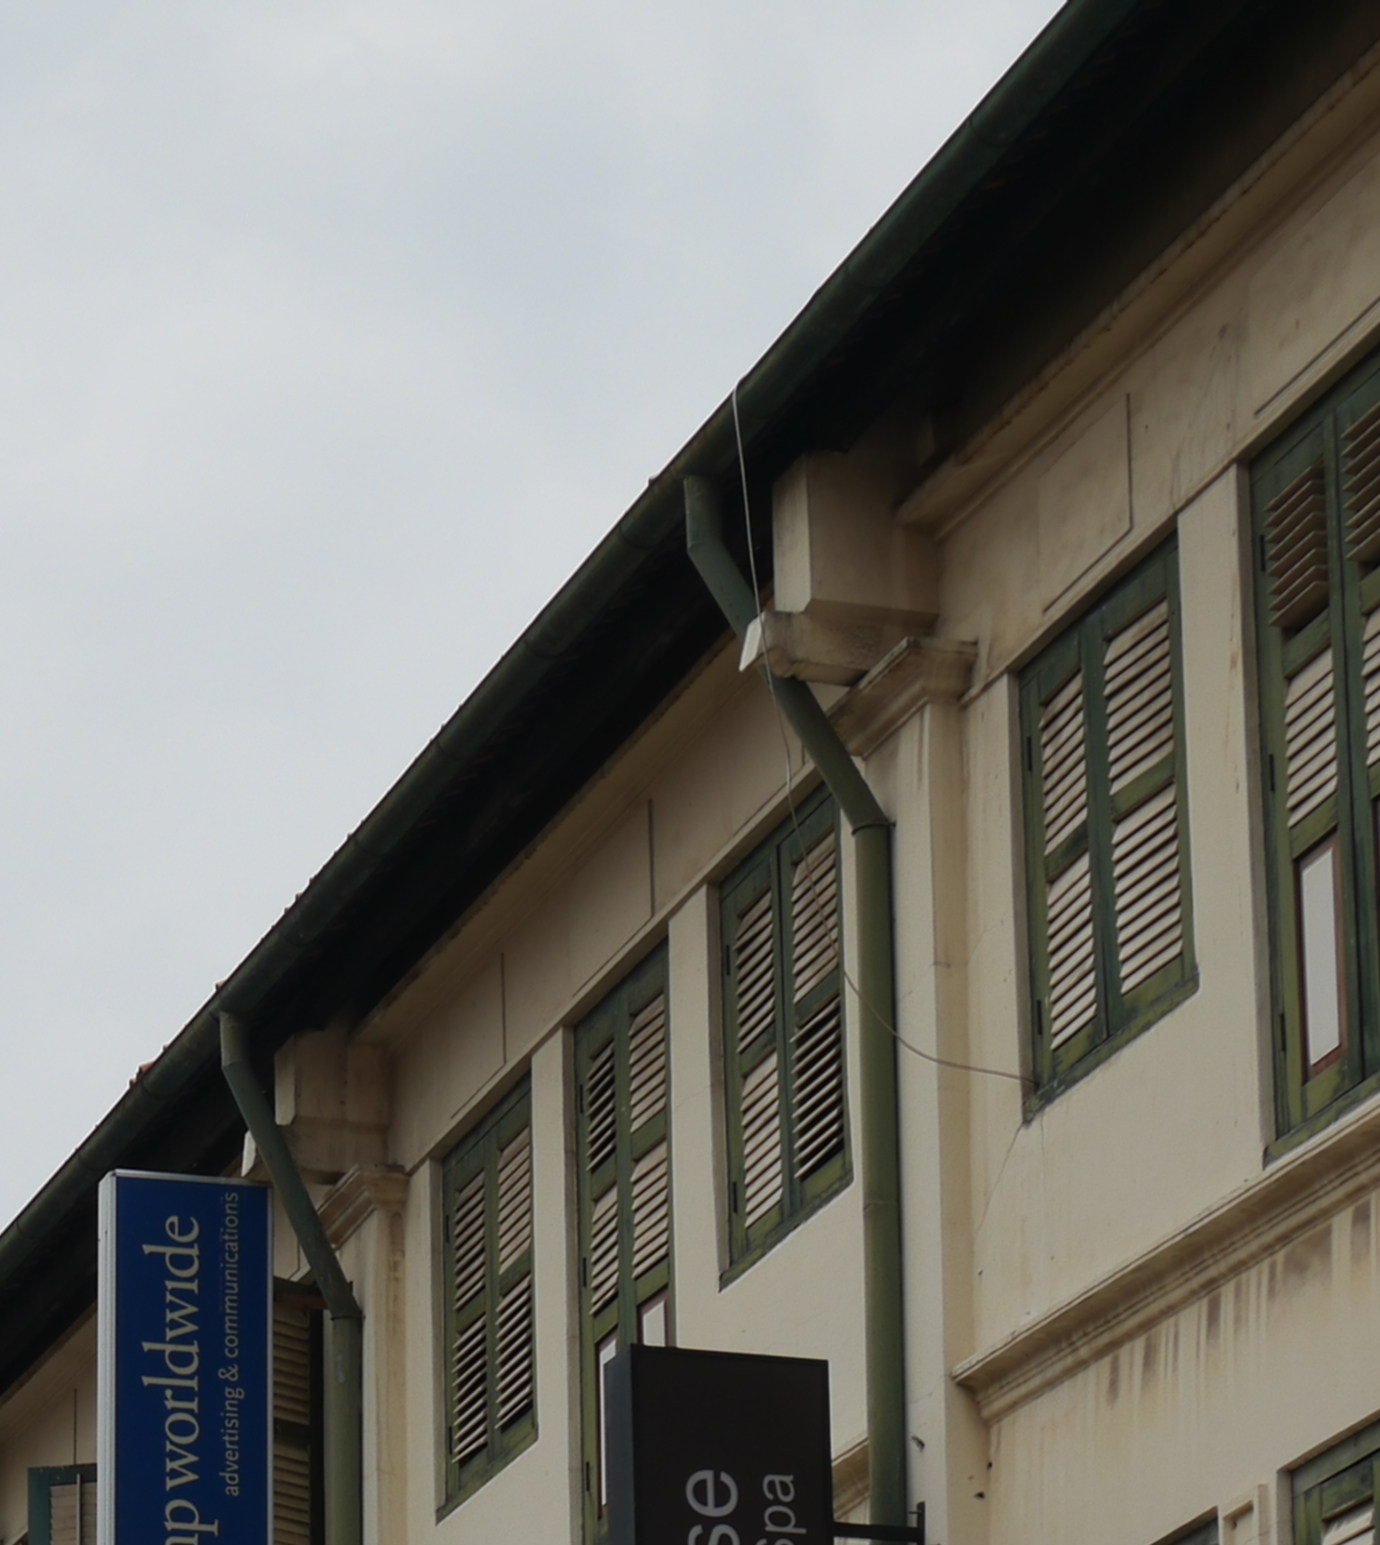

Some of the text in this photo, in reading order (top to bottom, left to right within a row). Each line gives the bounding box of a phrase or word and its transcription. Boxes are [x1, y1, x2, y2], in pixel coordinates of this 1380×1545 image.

[141, 1214, 201, 1492] worldwide
[217, 1190, 245, 1498] advertising & communications
